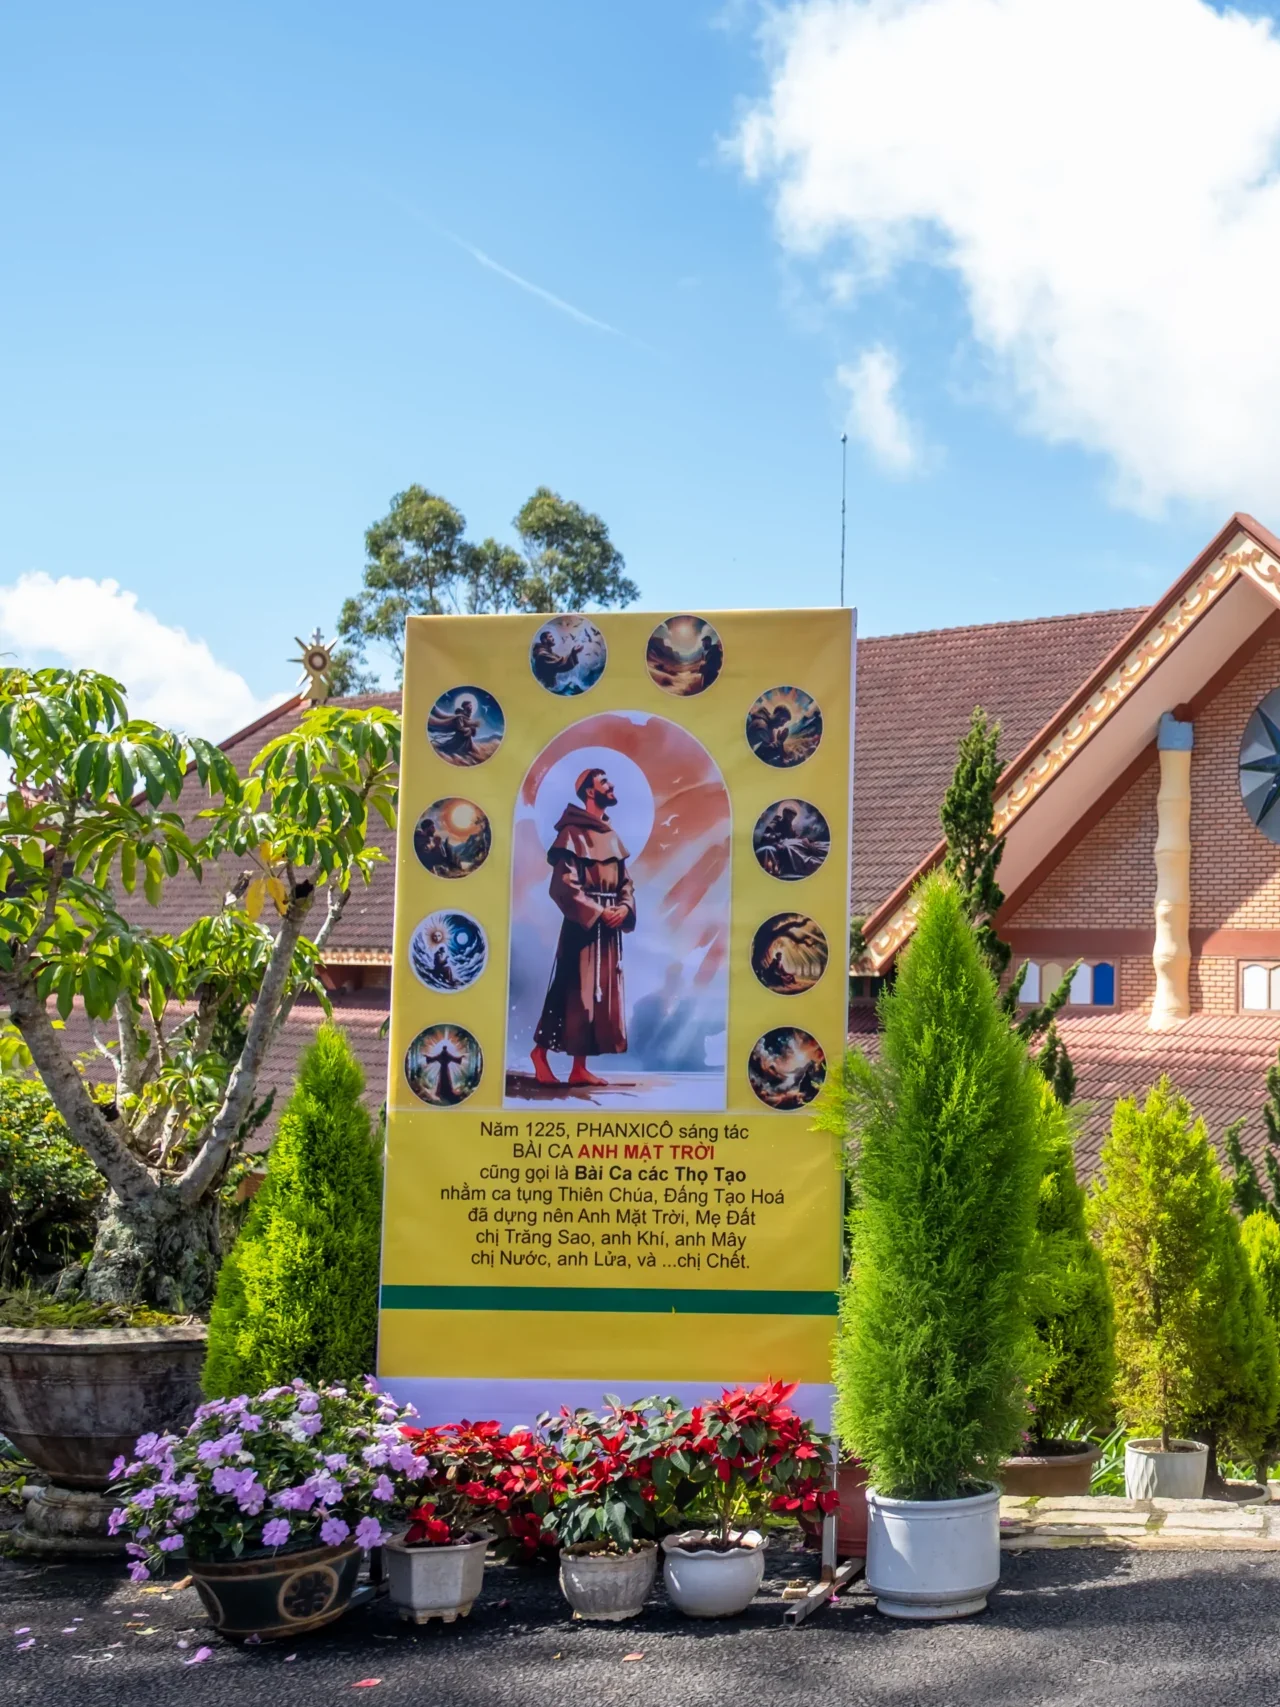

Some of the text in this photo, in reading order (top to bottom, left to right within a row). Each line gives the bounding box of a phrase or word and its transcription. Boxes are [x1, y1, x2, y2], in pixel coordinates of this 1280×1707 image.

[480, 1120, 749, 1142] Năm 1225, PHANXICÔ sáng tác
[513, 1140, 714, 1162] BÀI CA ANH MẶT TRỜI
[479, 1164, 746, 1186] cũng gọi là Bài Ca các Thọ Tạo
[440, 1181, 785, 1207] nhằm ca tụng Thiên Chúa, Đấng Tạo Hoá
[468, 1207, 756, 1228] đã dựng nên Anh Mặt Trời, Mẹ Đất
[475, 1228, 747, 1251] chị Trăng Sao, anh Khí, anh Mây
[471, 1250, 494, 1268] chị
[500, 1250, 551, 1268] Nước,
[557, 1251, 588, 1266] anh
[594, 1250, 631, 1269] Lửa,
[637, 1252, 656, 1267] và
[706, 1249, 750, 1269] Chết.
